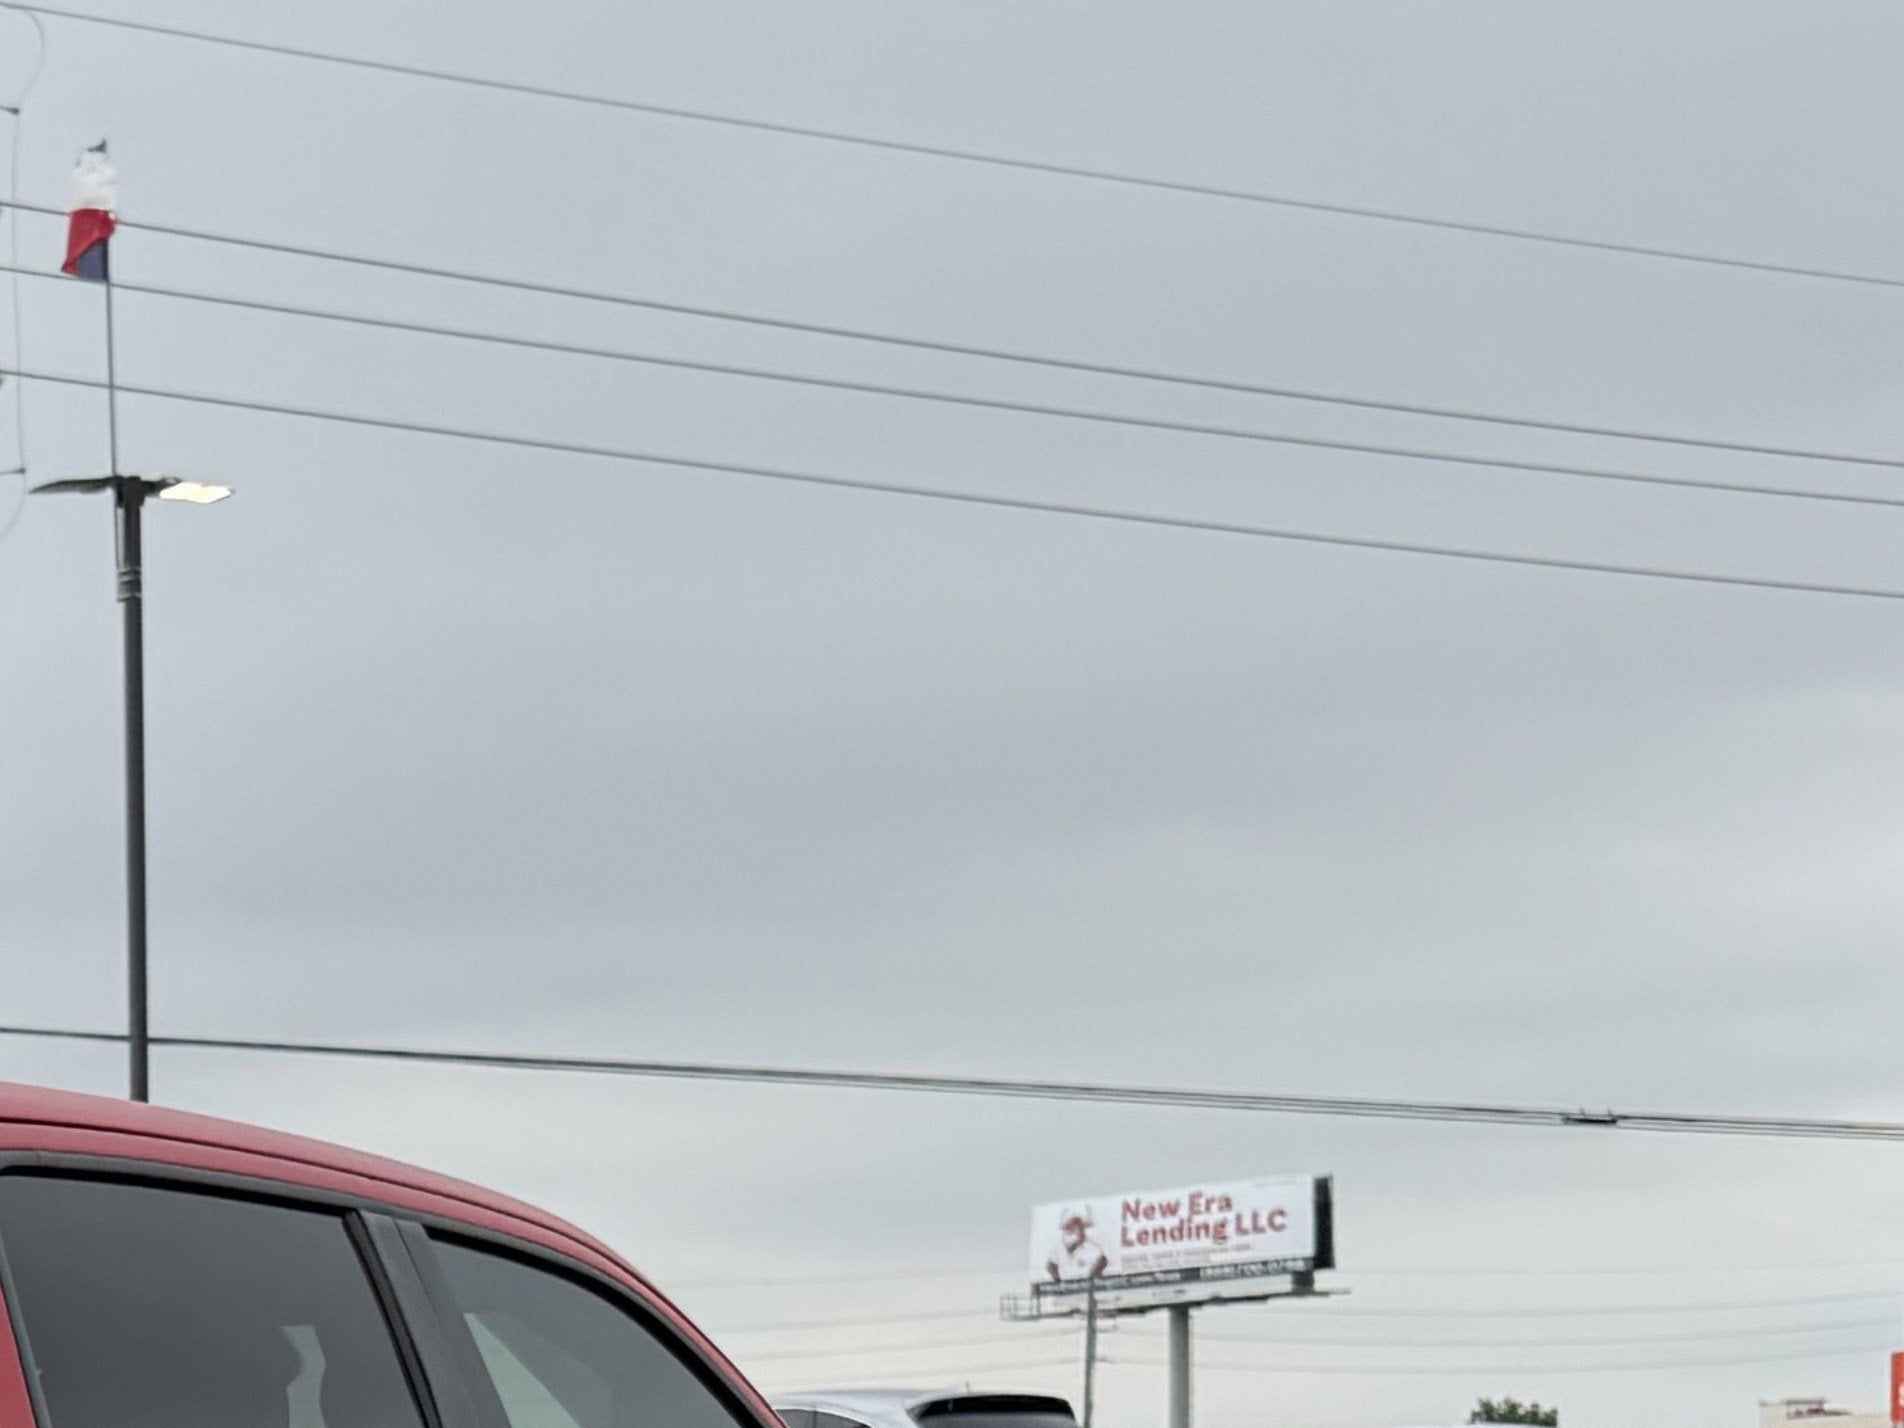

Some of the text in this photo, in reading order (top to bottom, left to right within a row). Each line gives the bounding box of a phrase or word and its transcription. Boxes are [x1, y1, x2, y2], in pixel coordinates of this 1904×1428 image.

[1121, 1191, 1234, 1223] New Era
[1120, 1208, 1289, 1248] Lending LLC
